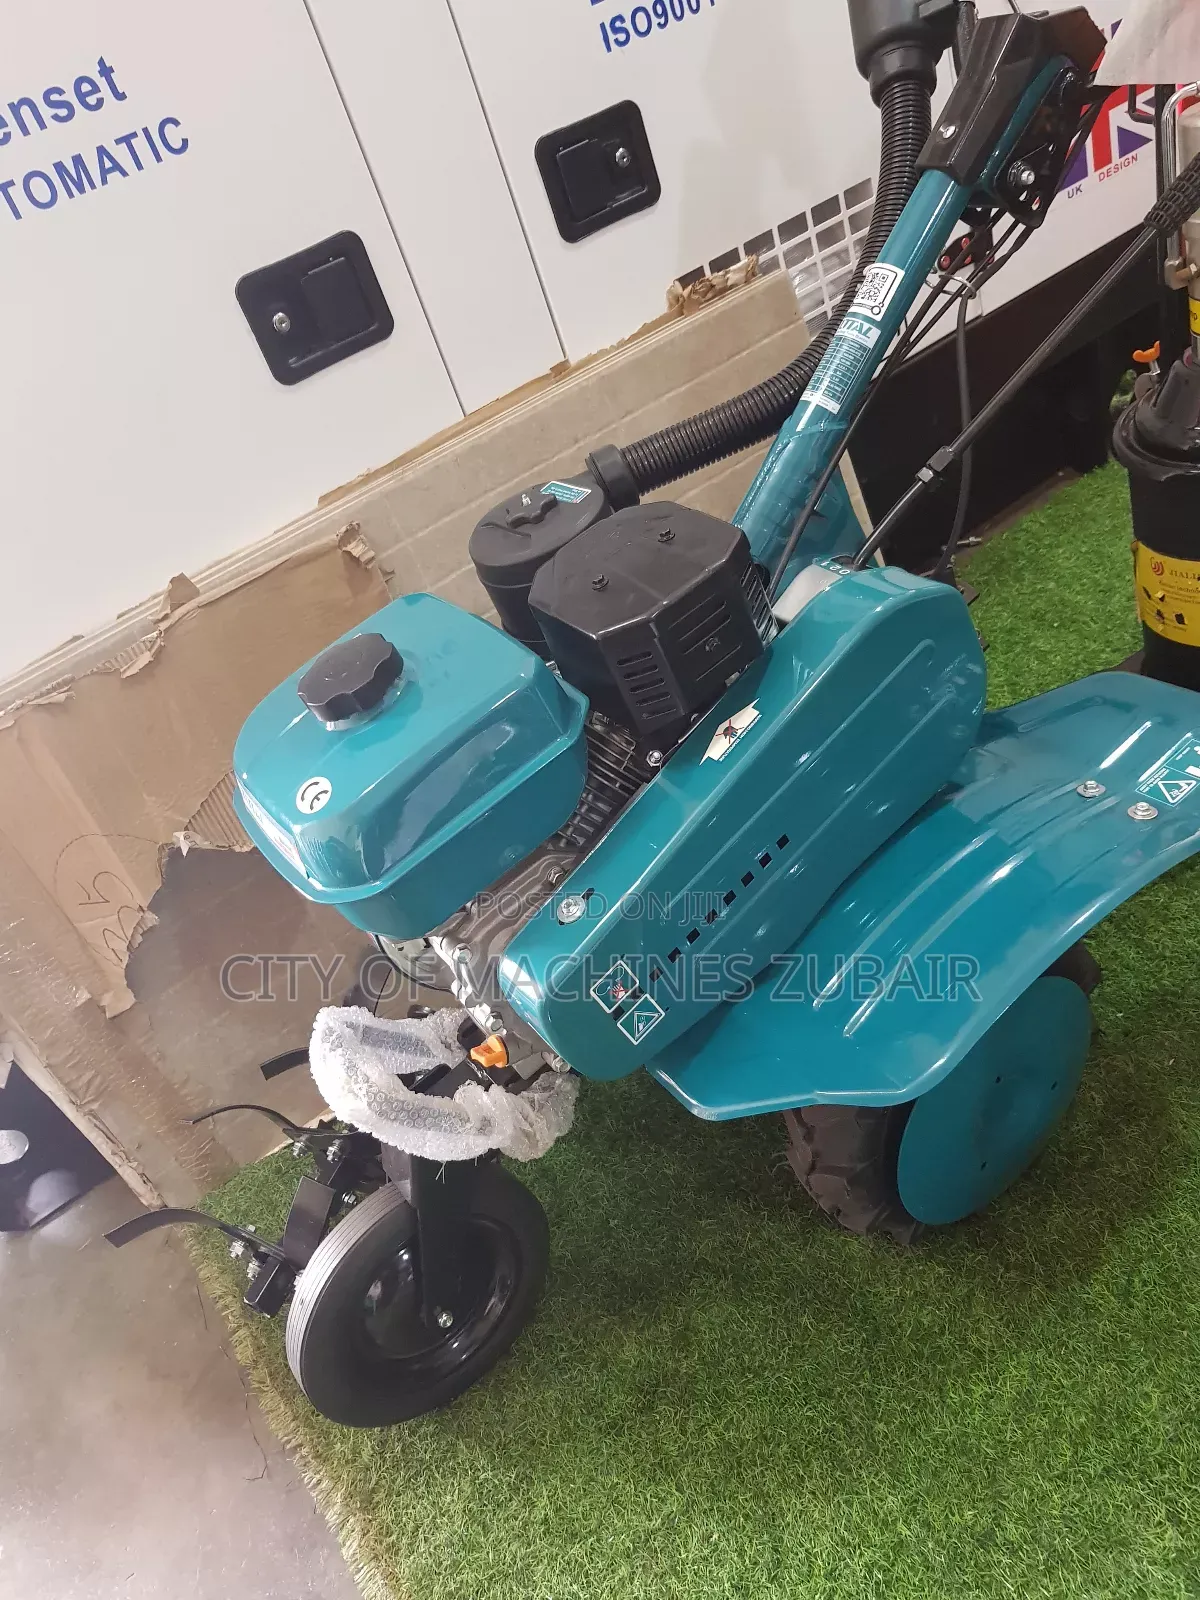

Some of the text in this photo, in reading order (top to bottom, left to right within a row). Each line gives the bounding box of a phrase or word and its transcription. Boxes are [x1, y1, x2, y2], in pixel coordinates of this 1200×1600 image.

[600, 0, 715, 53] ISO900
[0, 117, 189, 221] TOMATIC
[1067, 153, 1138, 199] UK DESIGN
